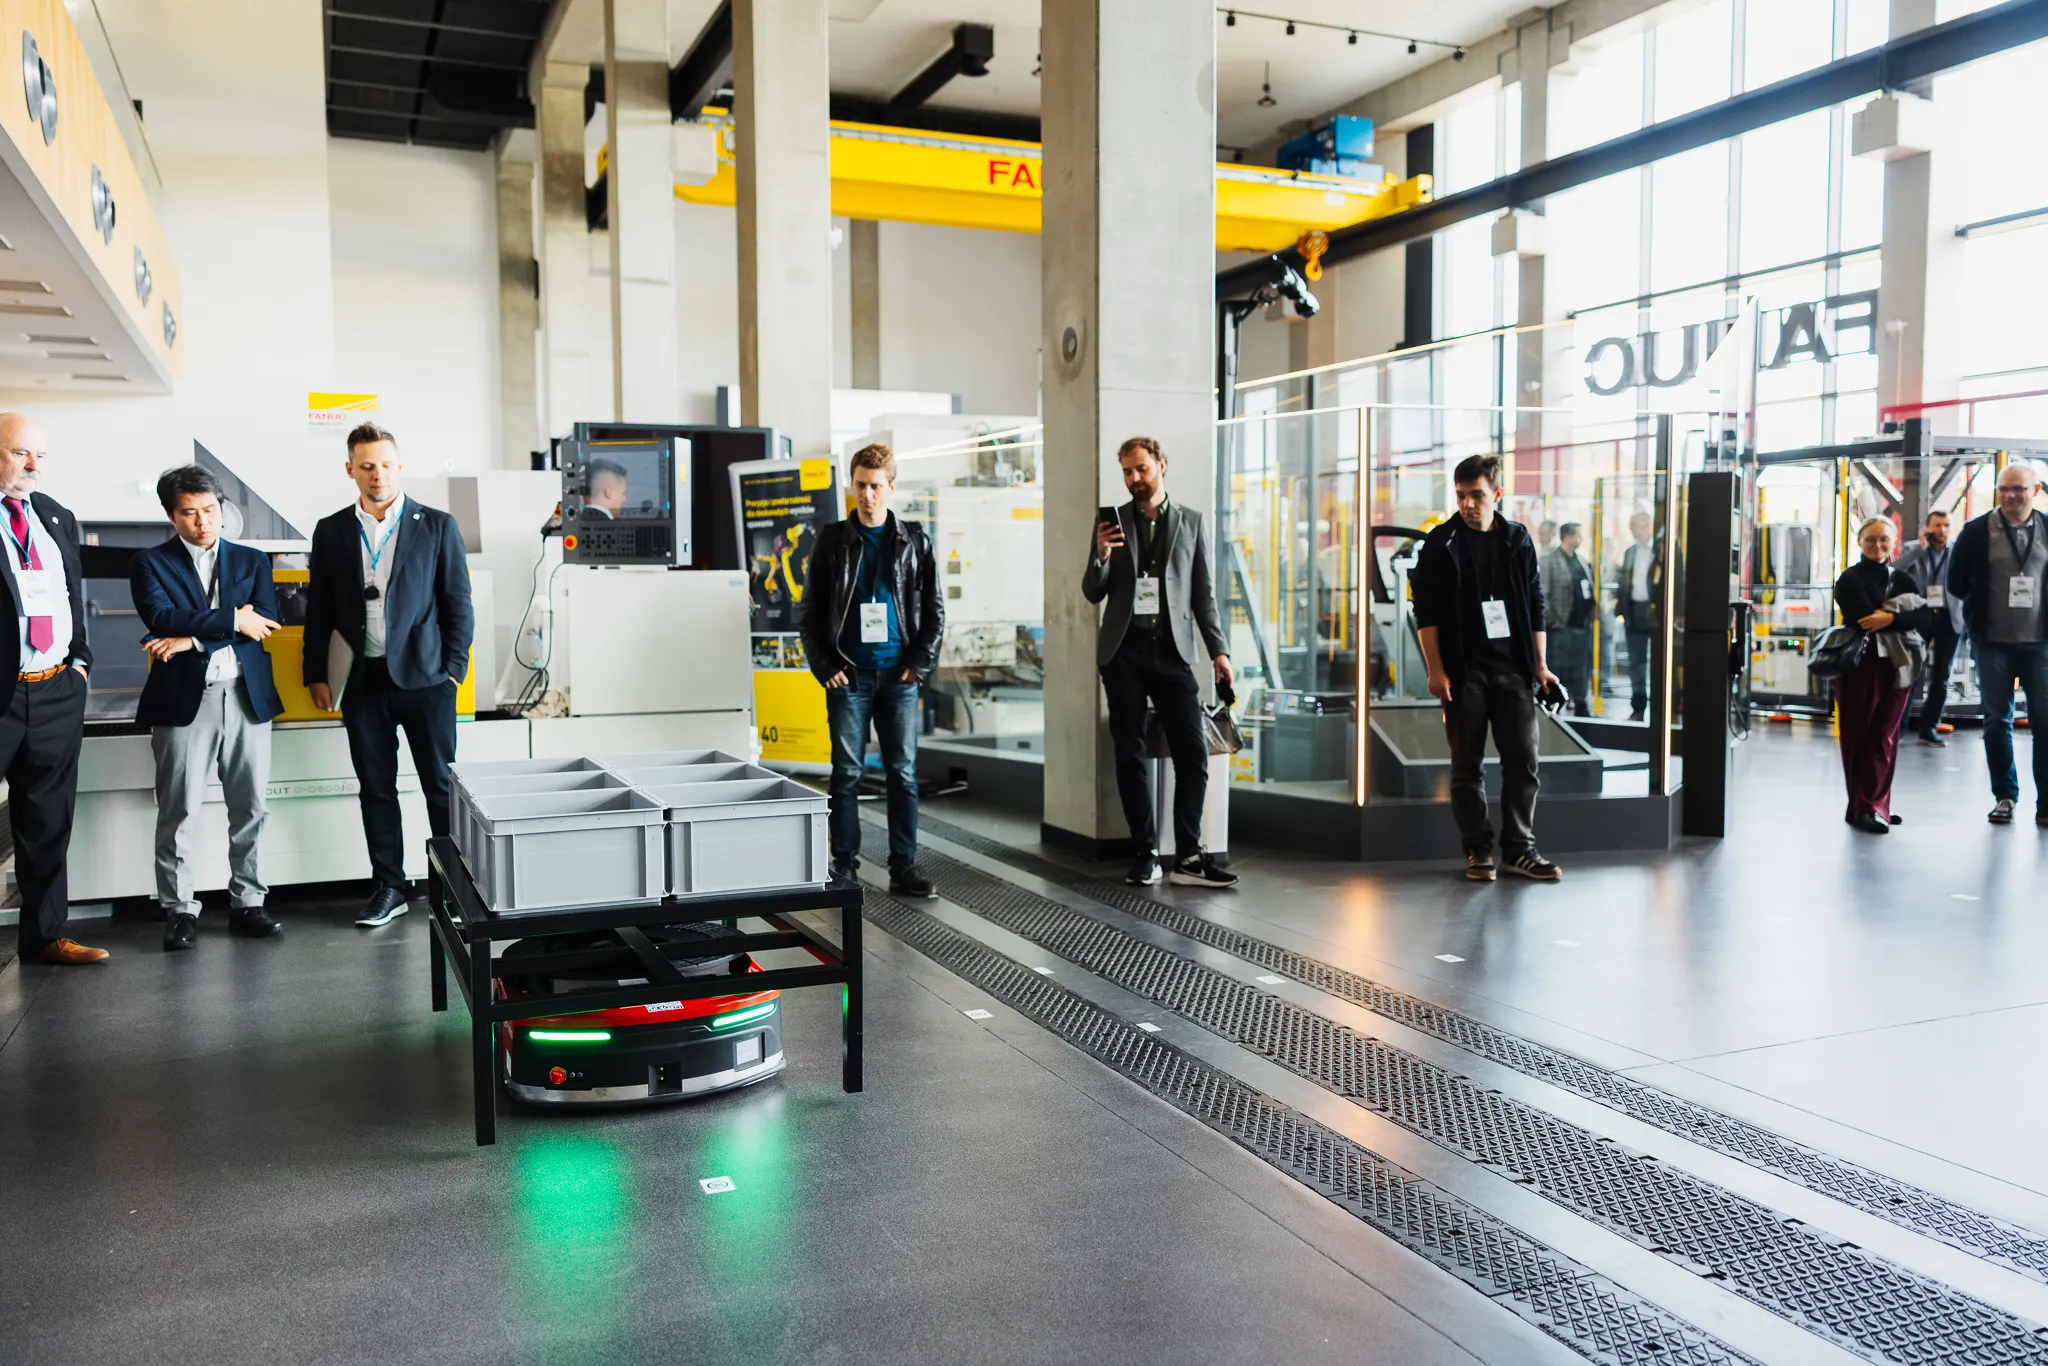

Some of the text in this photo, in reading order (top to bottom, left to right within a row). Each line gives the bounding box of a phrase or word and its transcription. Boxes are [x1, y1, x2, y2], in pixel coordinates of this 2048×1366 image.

[989, 160, 1042, 189] FA
[308, 412, 346, 420] FANUC
[761, 726, 779, 742] 40
